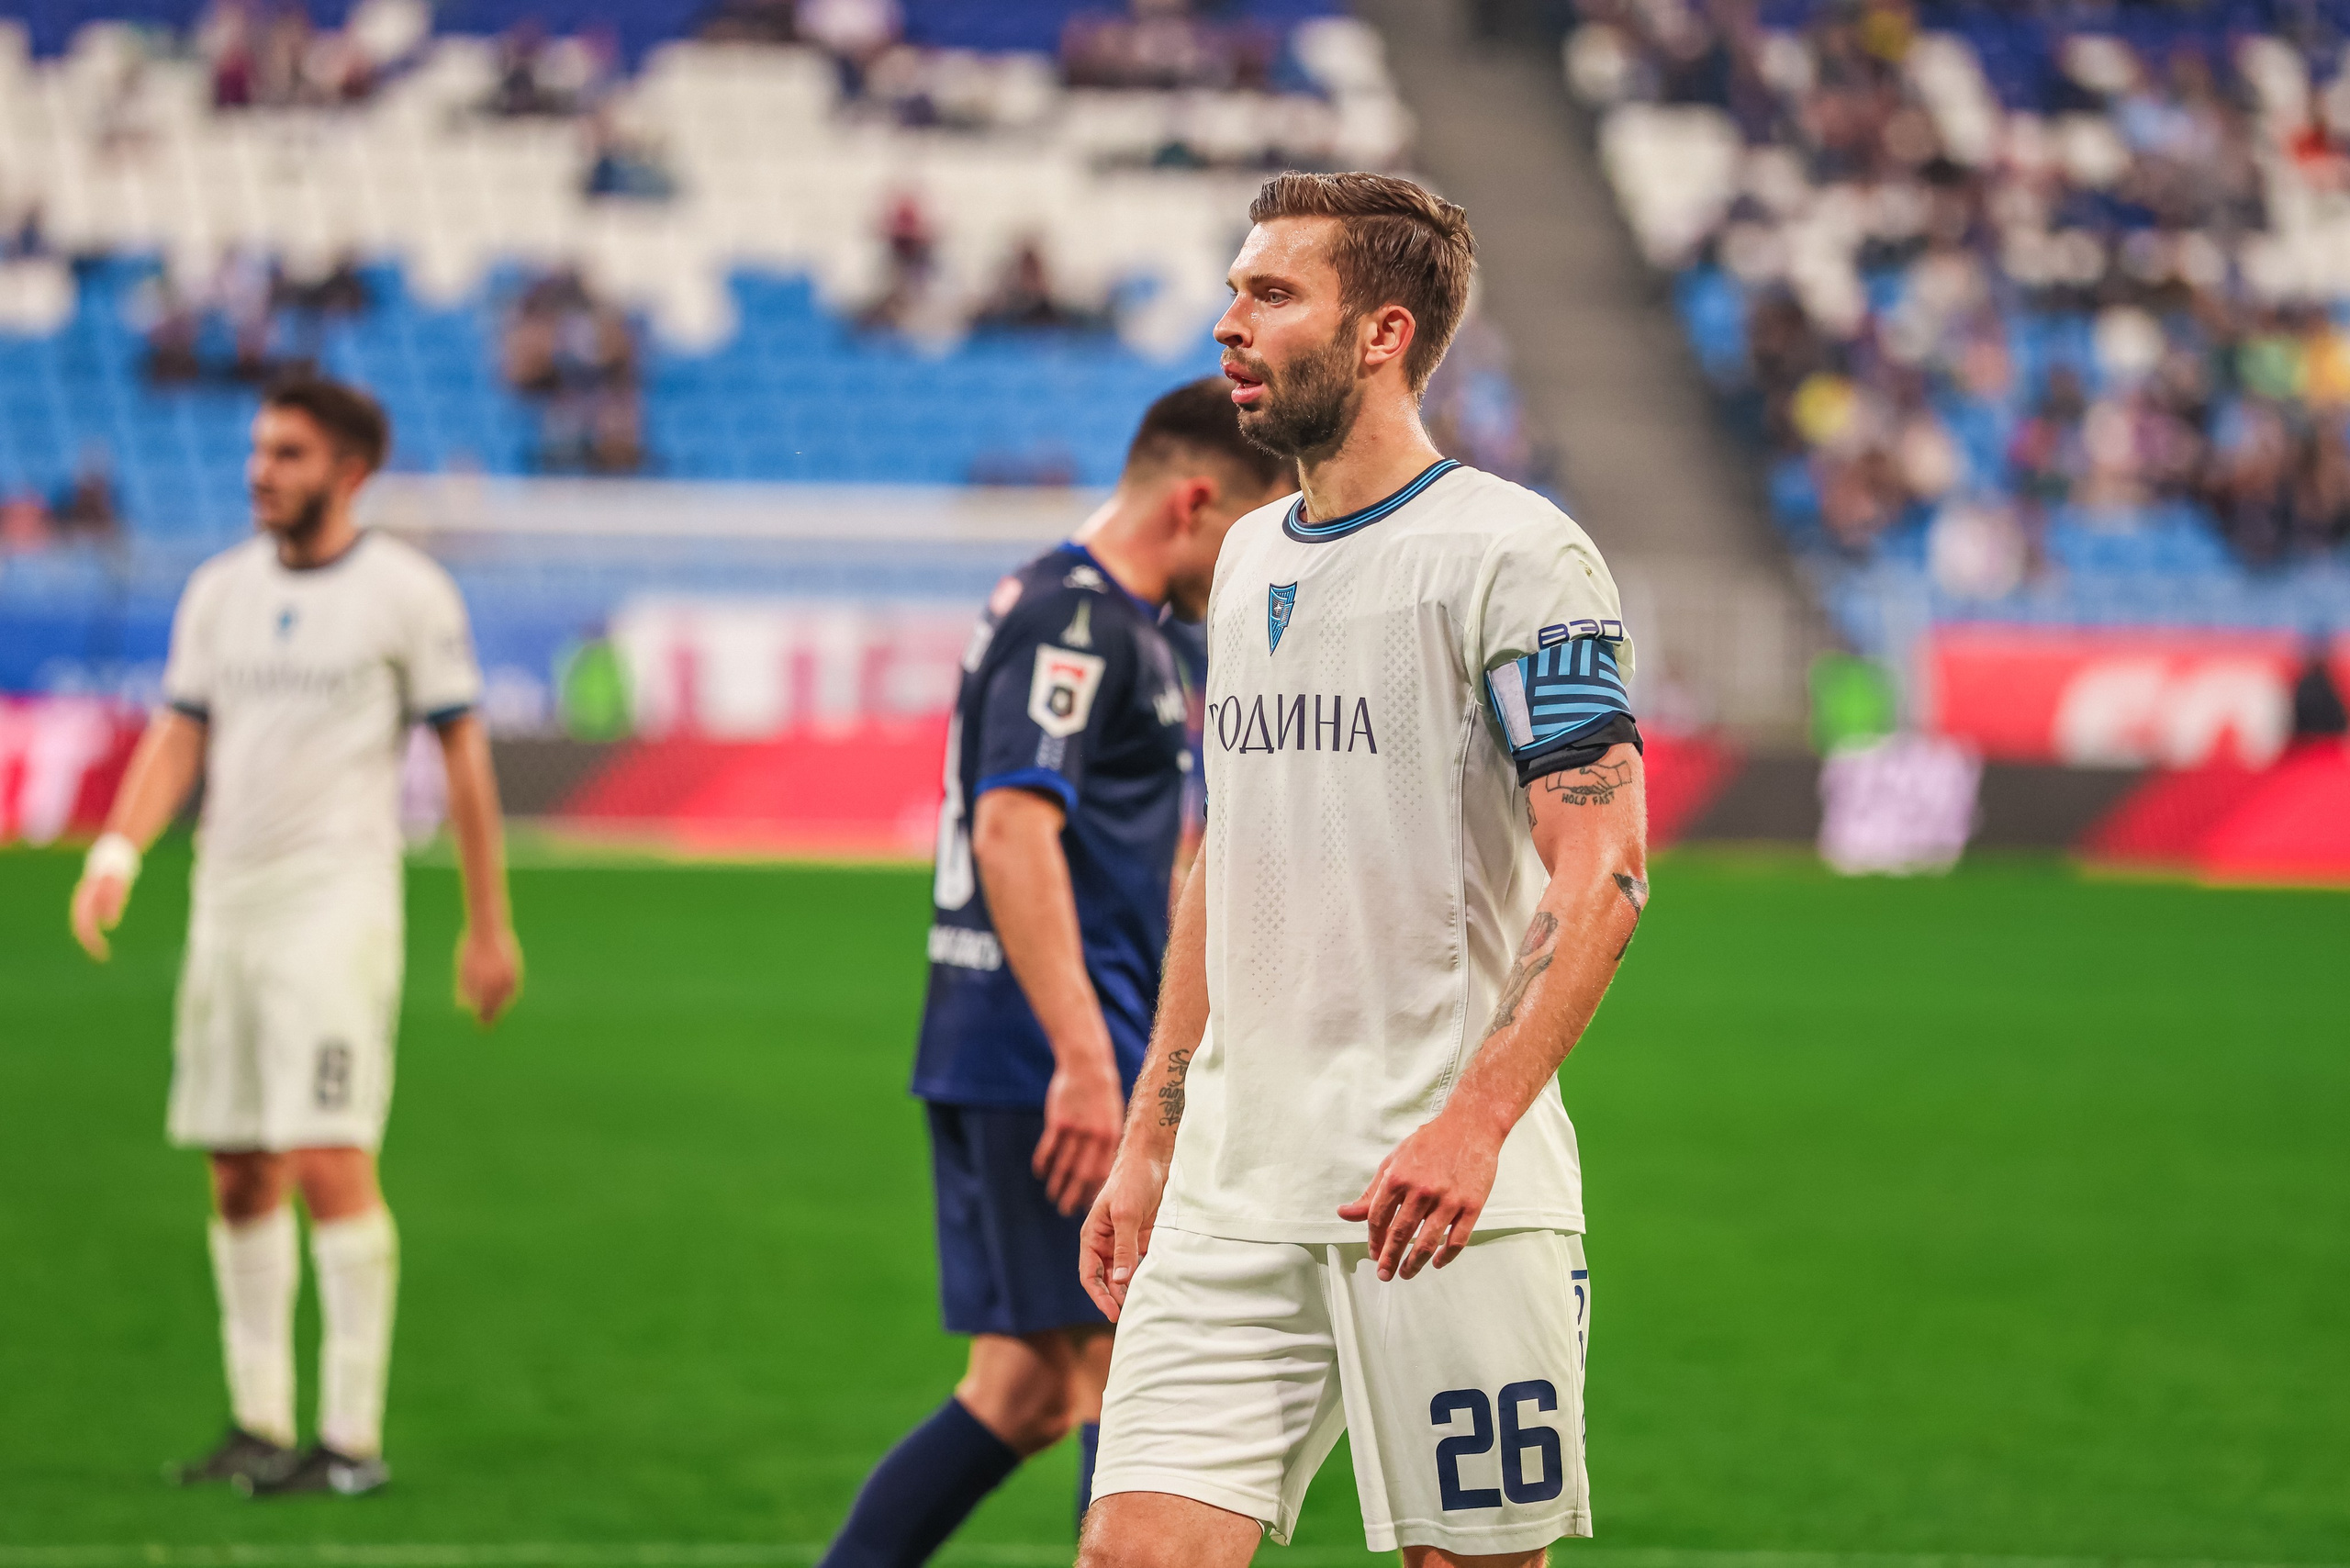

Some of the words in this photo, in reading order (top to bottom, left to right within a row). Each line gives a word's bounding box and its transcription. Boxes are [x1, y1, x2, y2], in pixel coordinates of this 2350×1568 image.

[1561, 792, 1587, 806] HOLD
[1592, 790, 1615, 806] FAST
[1429, 1379, 1563, 1512] 26
